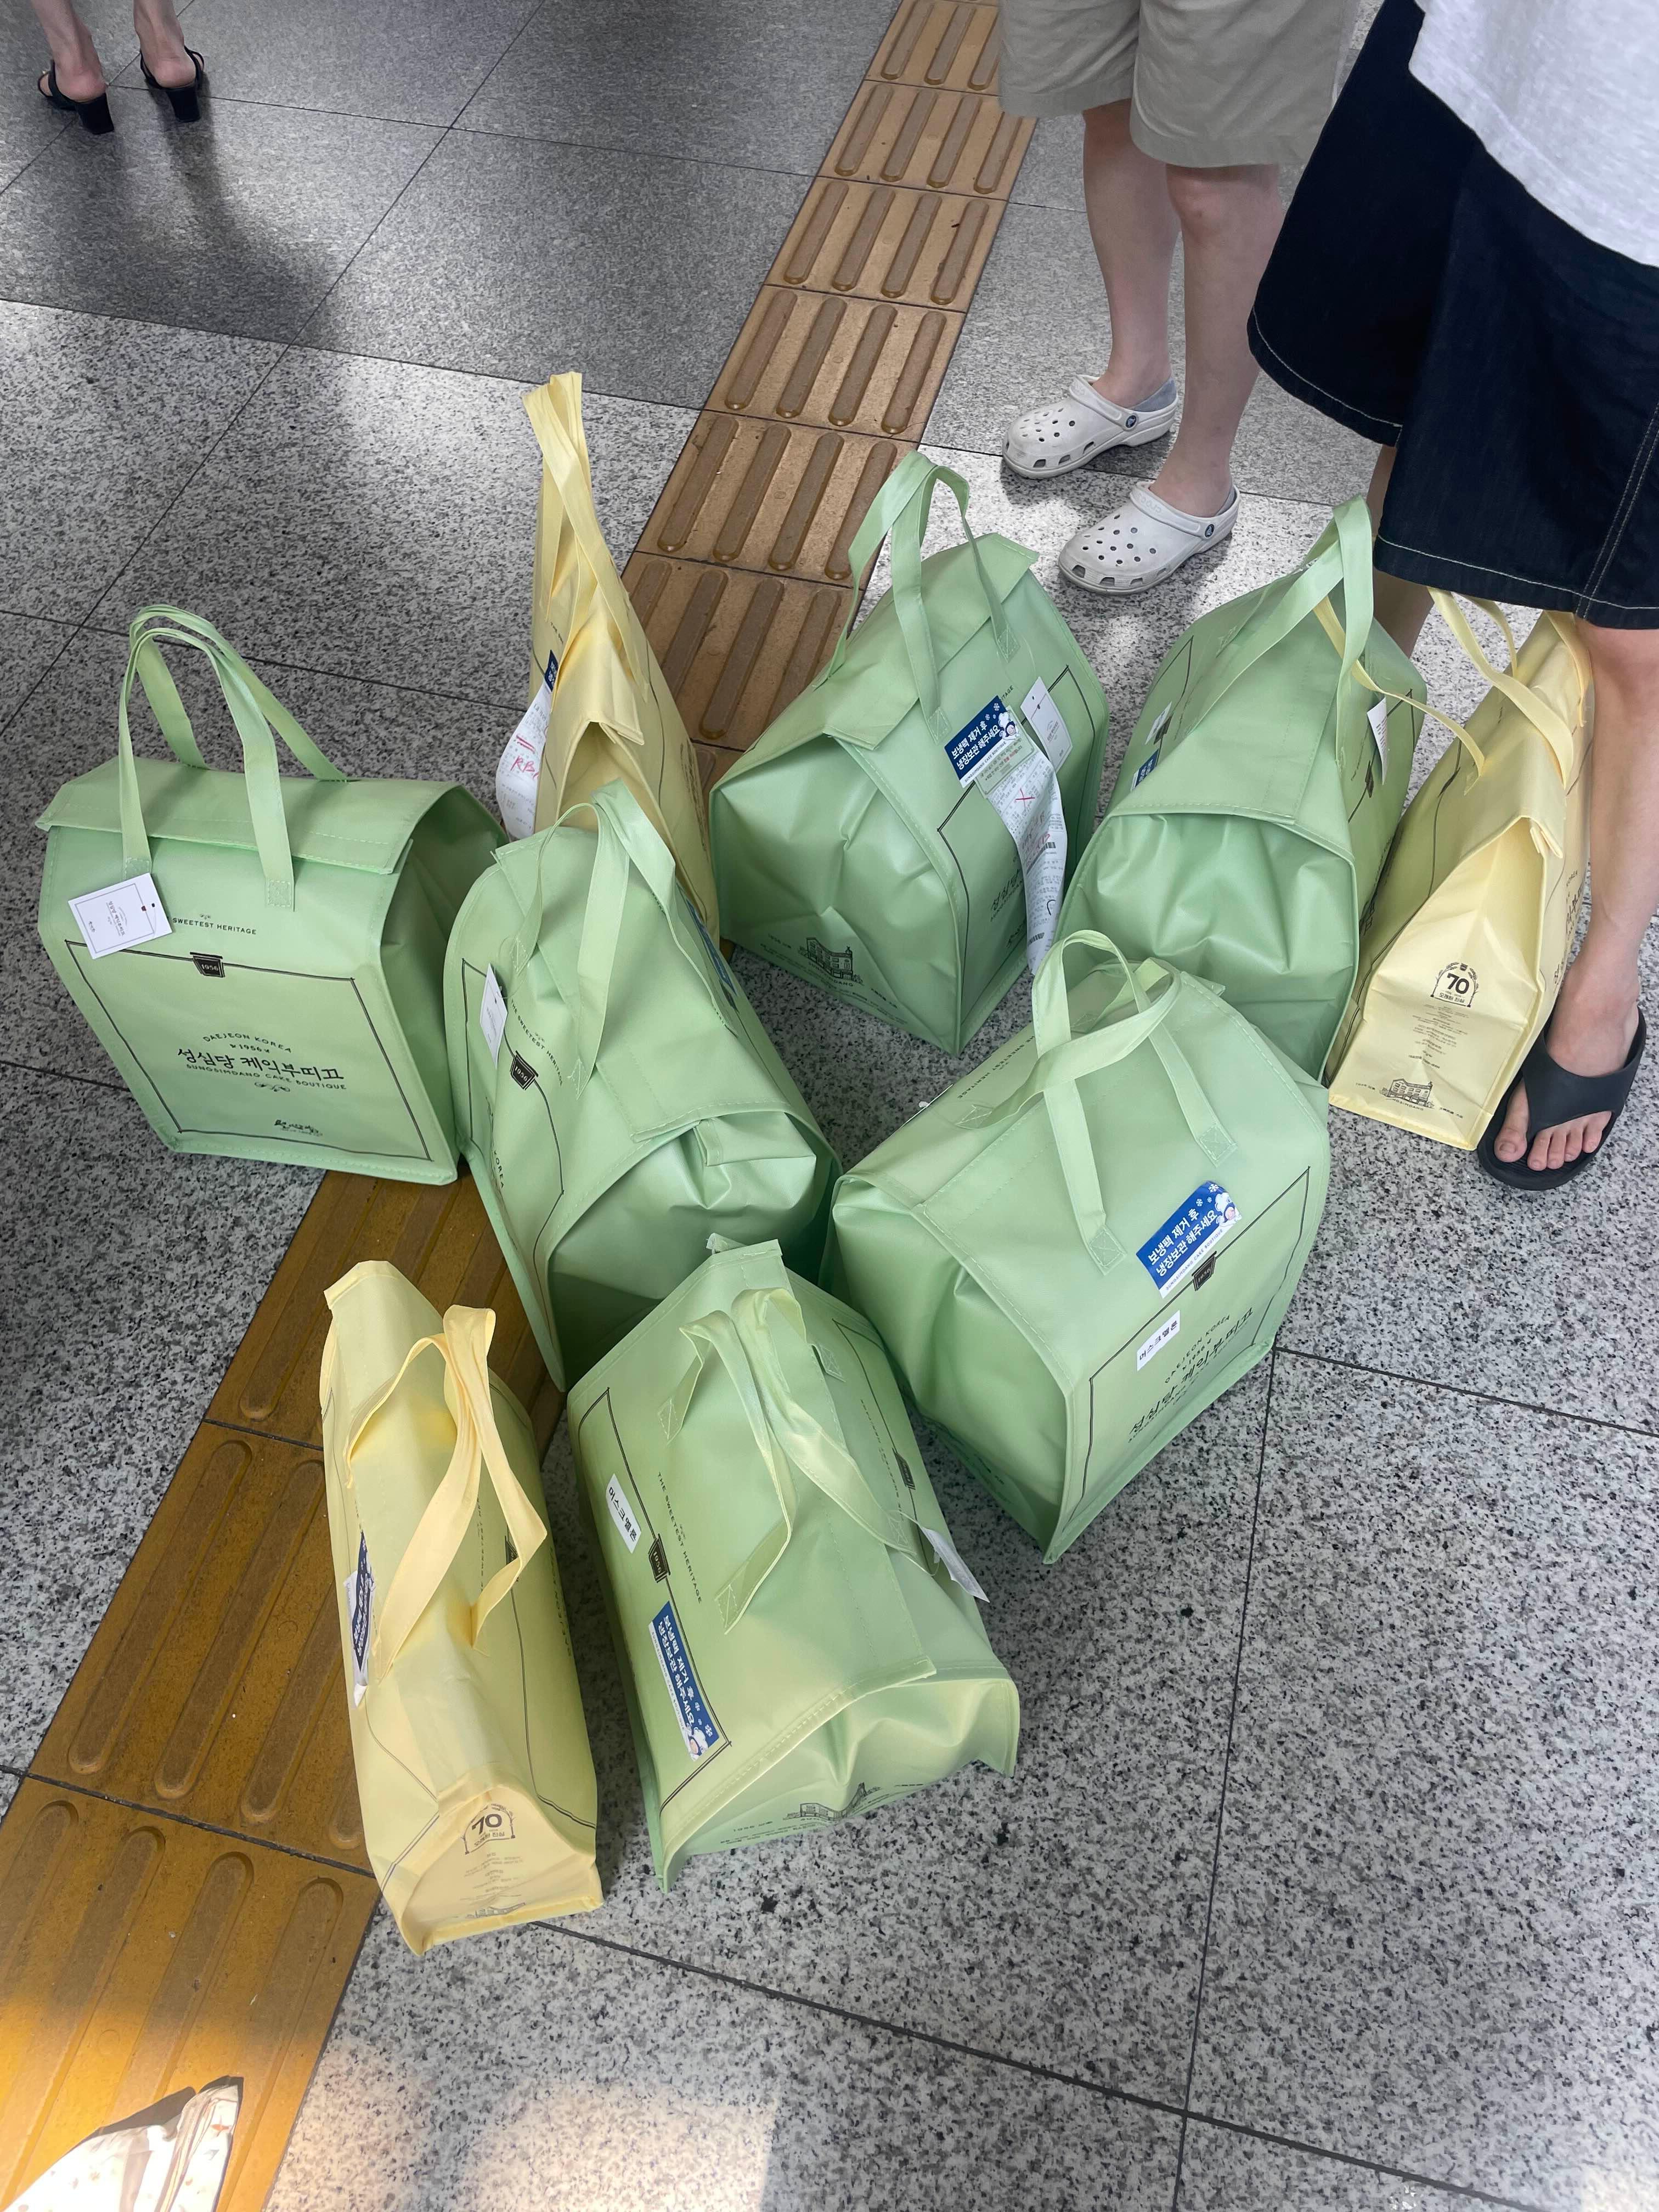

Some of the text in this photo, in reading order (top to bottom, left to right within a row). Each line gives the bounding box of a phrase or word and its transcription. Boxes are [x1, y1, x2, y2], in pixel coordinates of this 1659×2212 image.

[956, 744, 980, 770] 냉장보관
[978, 725, 1001, 748] 해주세요
[968, 726, 981, 742] 제거
[980, 720, 988, 731] 후
[172, 917, 257, 935] SWEETEST HERITAGE
[1447, 972, 1470, 994] 70
[178, 1048, 235, 1069] 성심당
[202, 1032, 291, 1053] DAEJEON KOREA
[517, 1015, 545, 1050] SWEETEST
[546, 1050, 563, 1086] HERITAGE
[296, 1080, 347, 1090] BOUTIQUE
[515, 1066, 528, 1082] 1956
[957, 1072, 990, 1098] HERITAGE
[1148, 1208, 1199, 1265] 보냉팩 제거 후
[1156, 1210, 1218, 1277] 냉장보관 해주세요
[1166, 1261, 1193, 1290] SUNGSIMDANG
[1194, 1249, 1204, 1261] CAKE
[1139, 1320, 1178, 1361] 머스크멜론
[1165, 1314, 1230, 1384] DAEJEON KOREA
[1129, 1384, 1178, 1434] 성심당
[608, 1487, 637, 1542] 머스크멜론
[658, 1472, 702, 1604] THE SWEETEST HERITAGE
[663, 1615, 679, 1655] 보냉팩
[677, 1656, 689, 1684] 제거
[658, 1621, 695, 1727] 냉장보관 해주세요
[472, 1813, 503, 1835] 70
